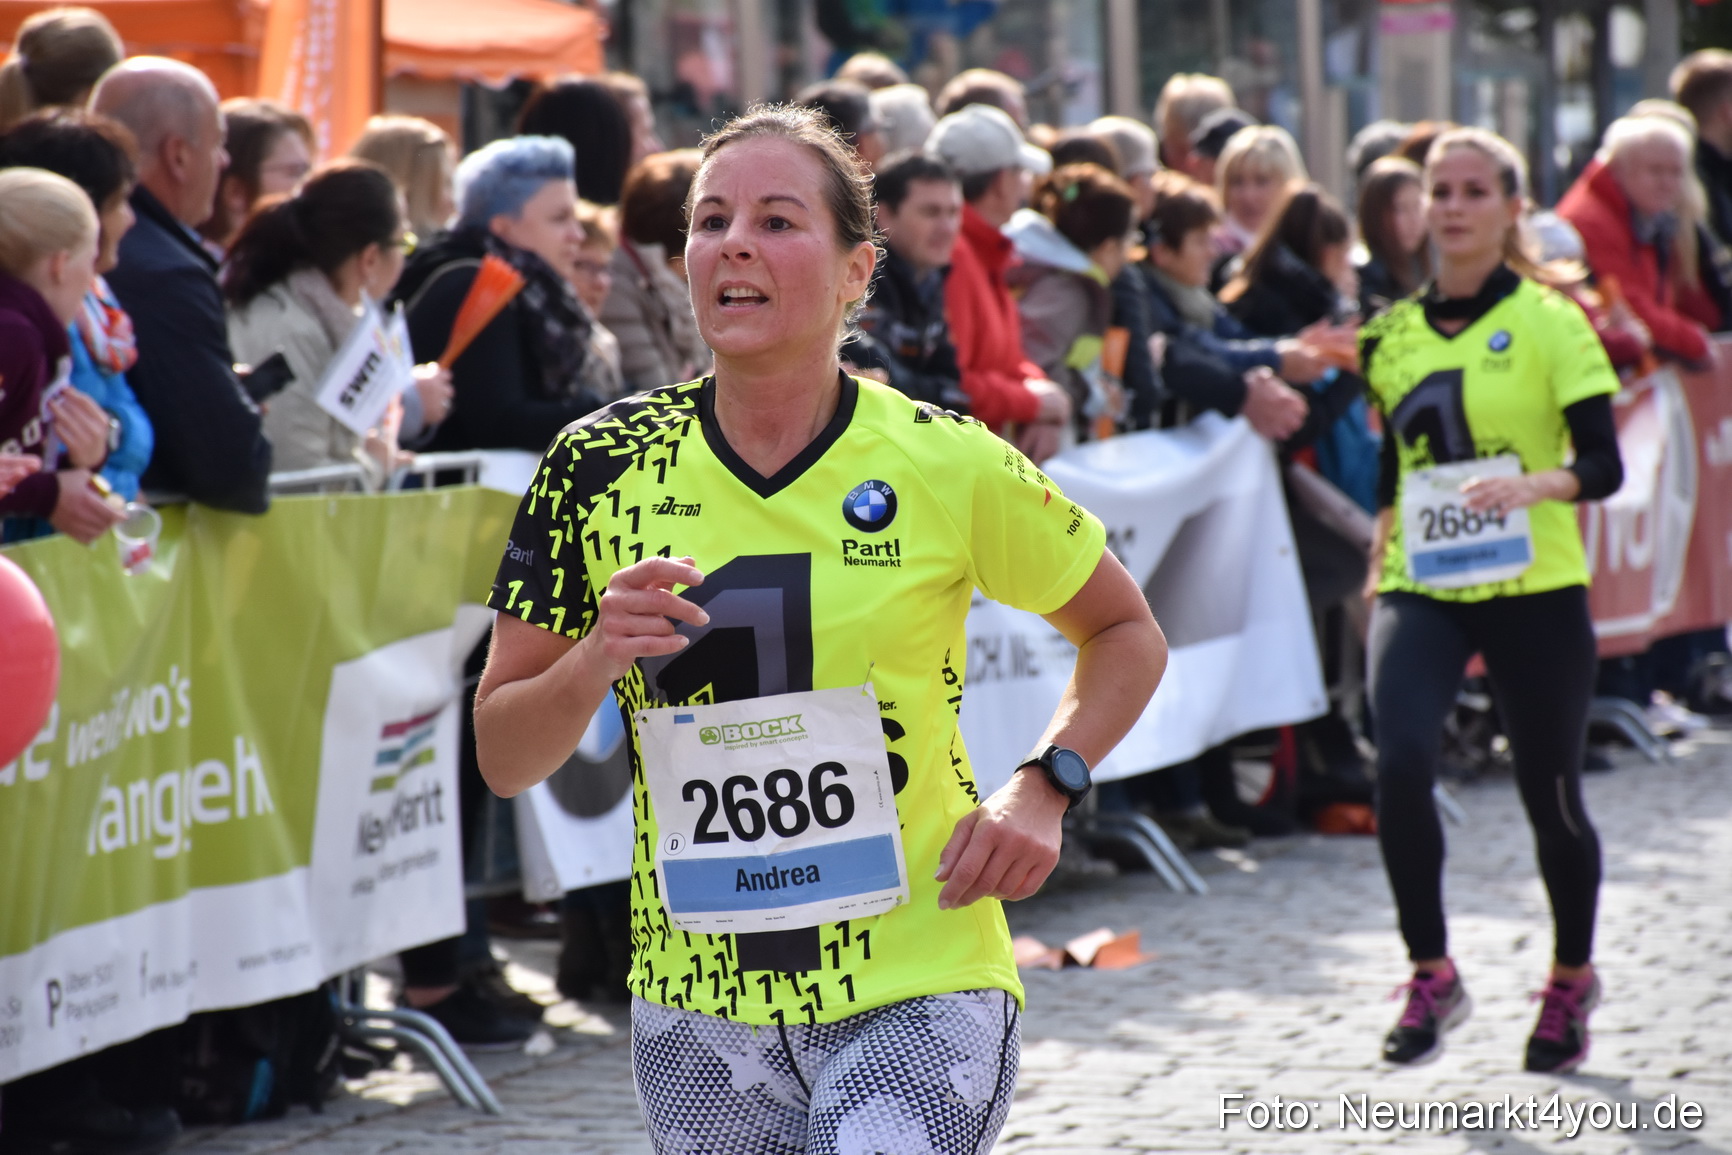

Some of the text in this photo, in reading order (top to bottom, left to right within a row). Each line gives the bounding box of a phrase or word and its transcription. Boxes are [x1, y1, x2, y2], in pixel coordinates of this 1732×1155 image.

[848, 481, 893, 501] BMW
[842, 539, 900, 557] Partl
[844, 556, 902, 568] Neumarkt
[721, 714, 806, 744] BOCK
[724, 743, 749, 751] inspired
[760, 738, 778, 746] smart
[779, 734, 809, 744] concepts
[682, 761, 855, 845] 2686
[670, 839, 679, 851] D
[735, 864, 821, 893] Andrea
